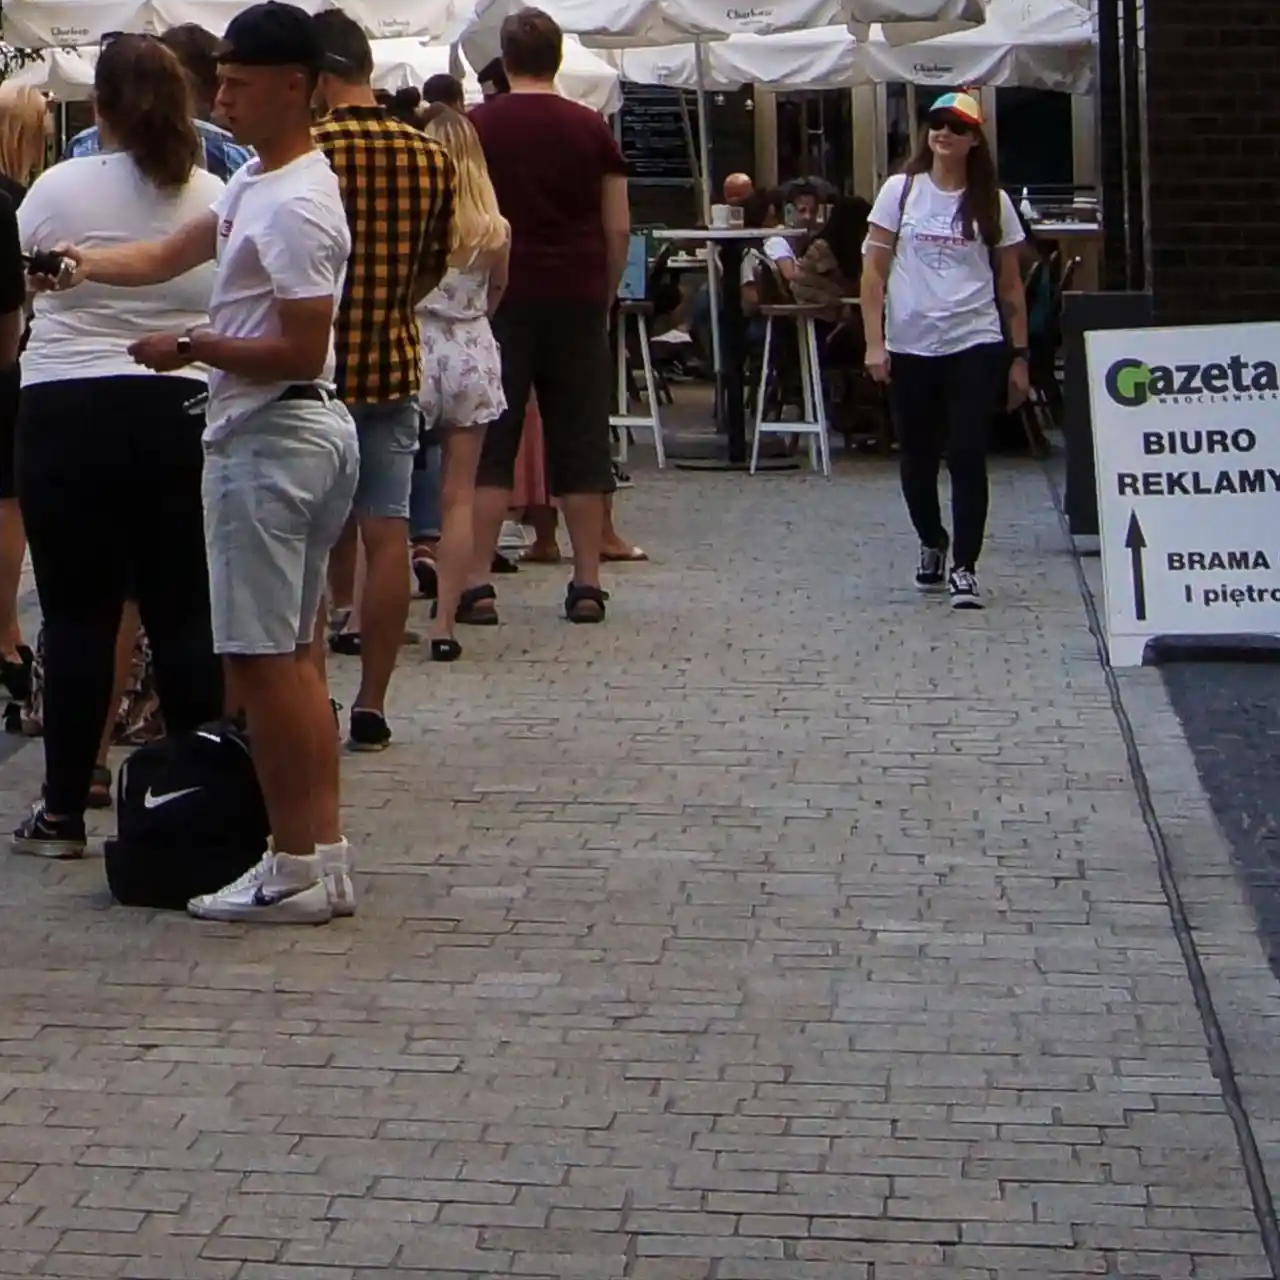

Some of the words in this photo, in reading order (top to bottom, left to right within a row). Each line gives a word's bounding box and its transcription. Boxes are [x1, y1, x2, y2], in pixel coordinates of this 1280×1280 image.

[1105, 354, 1279, 407] Gazeta
[1142, 428, 1256, 456] BIURO
[1117, 467, 1280, 497] REKLAMY
[1167, 550, 1271, 571] BRAMA
[1203, 583, 1280, 608] piętro
